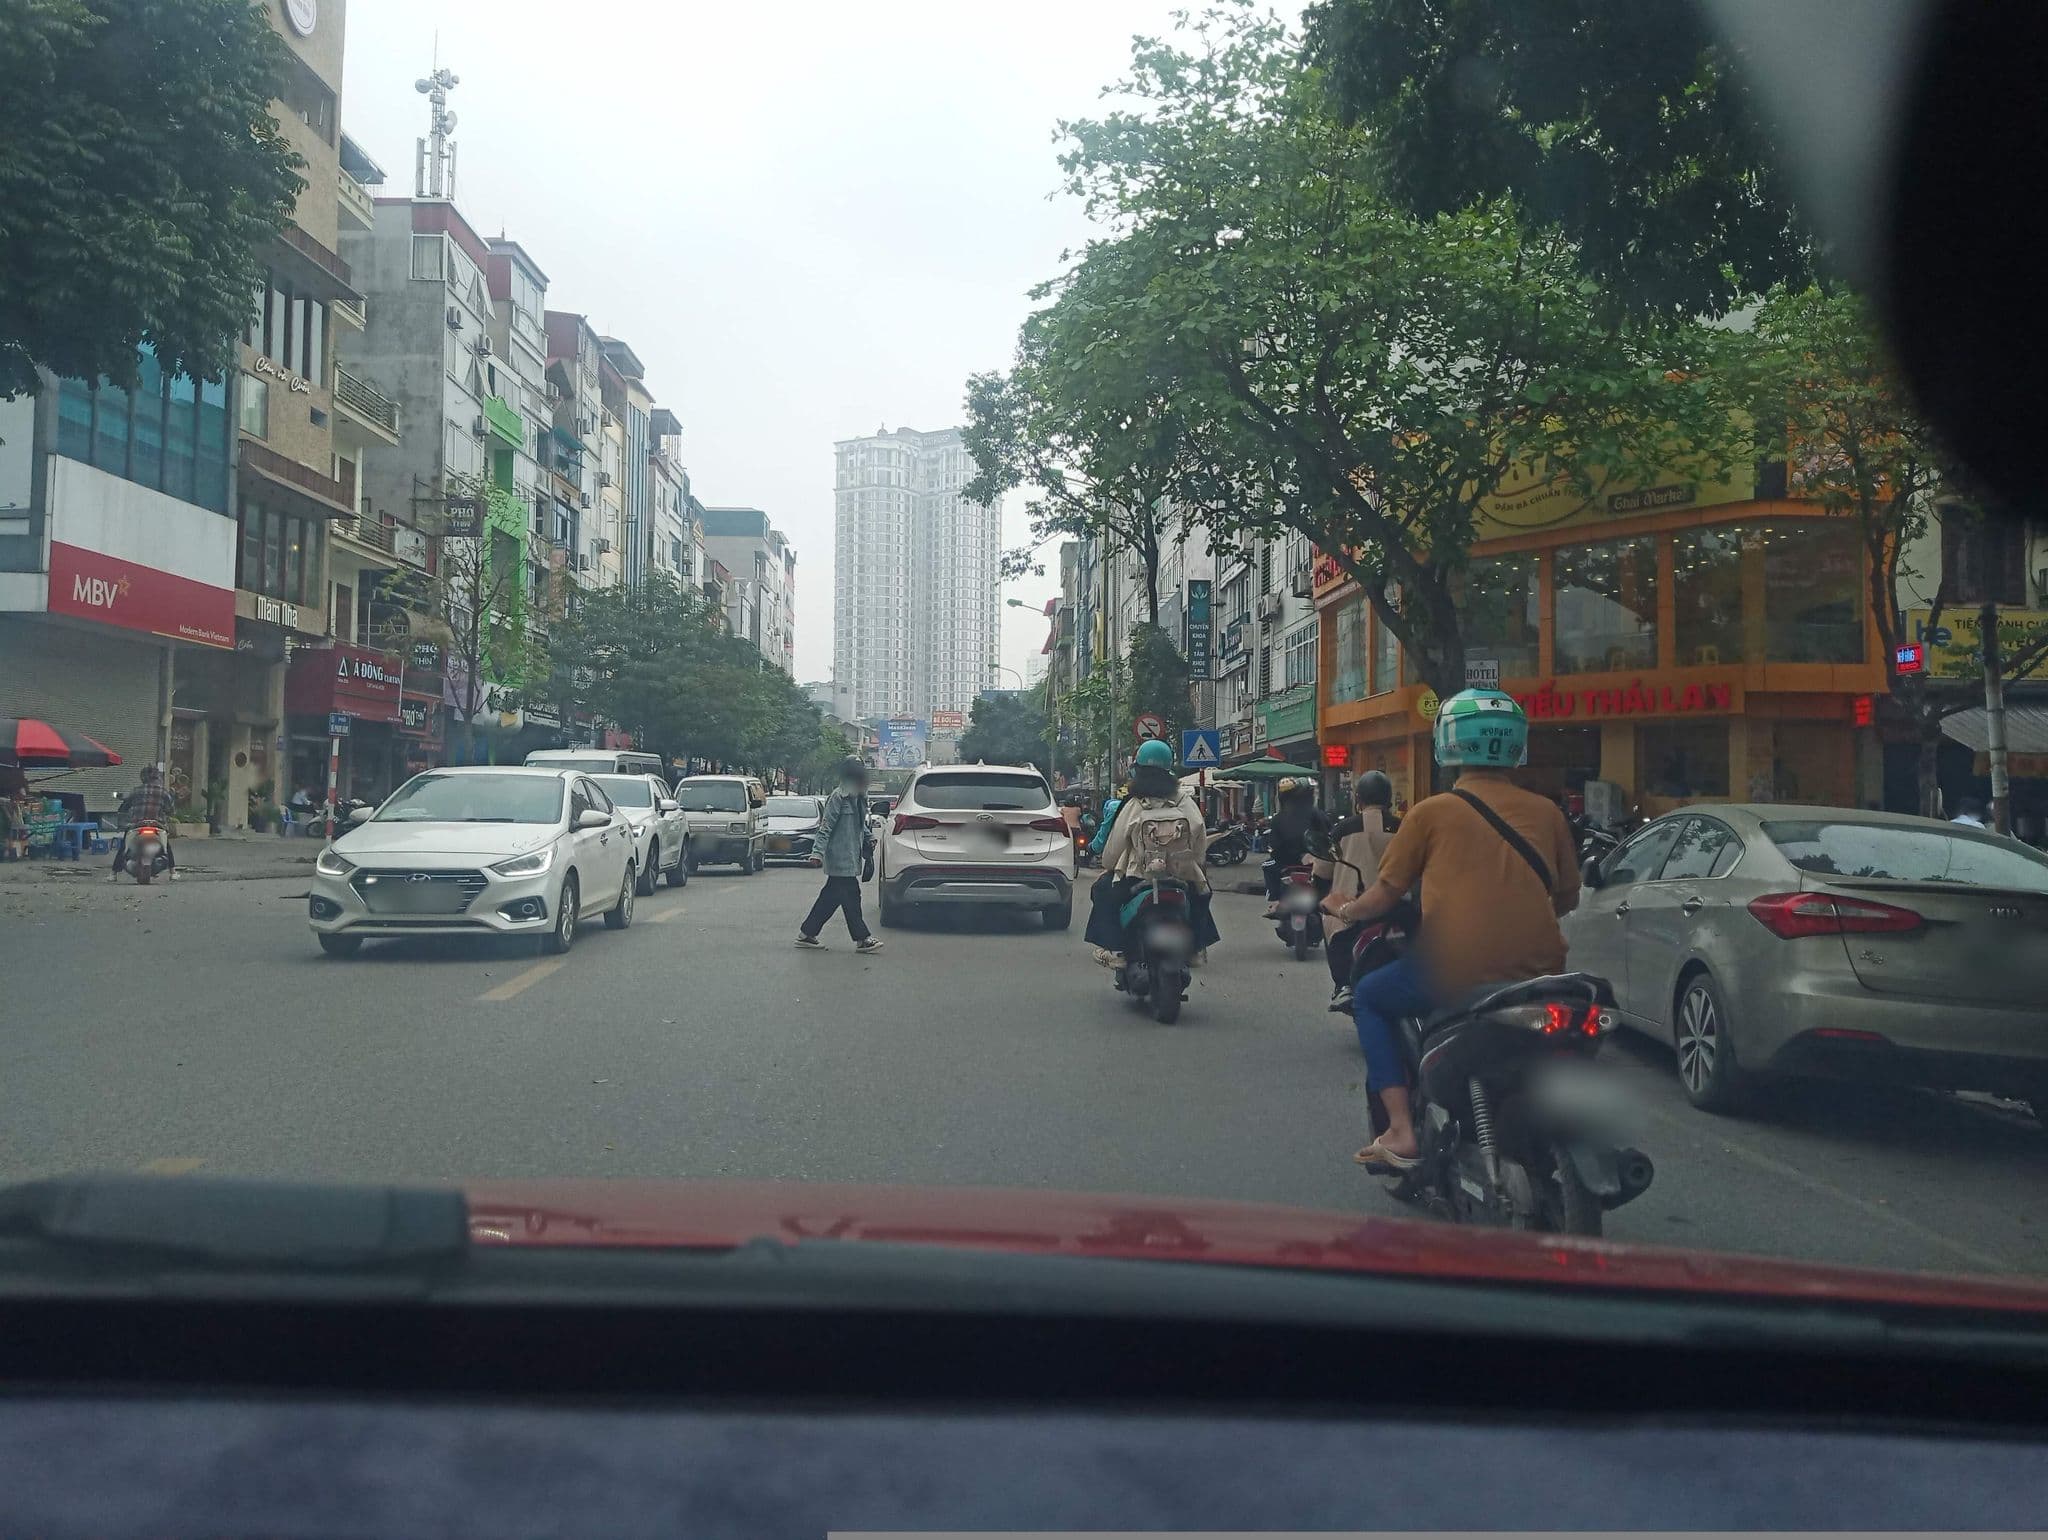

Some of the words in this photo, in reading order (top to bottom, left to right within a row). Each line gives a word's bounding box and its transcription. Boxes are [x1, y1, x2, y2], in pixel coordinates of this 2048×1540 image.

[72, 574, 118, 608] MBV
[179, 624, 198, 636] Modern
[1466, 669, 1498, 680] HOTEL
[1661, 683, 1731, 711] LAN
